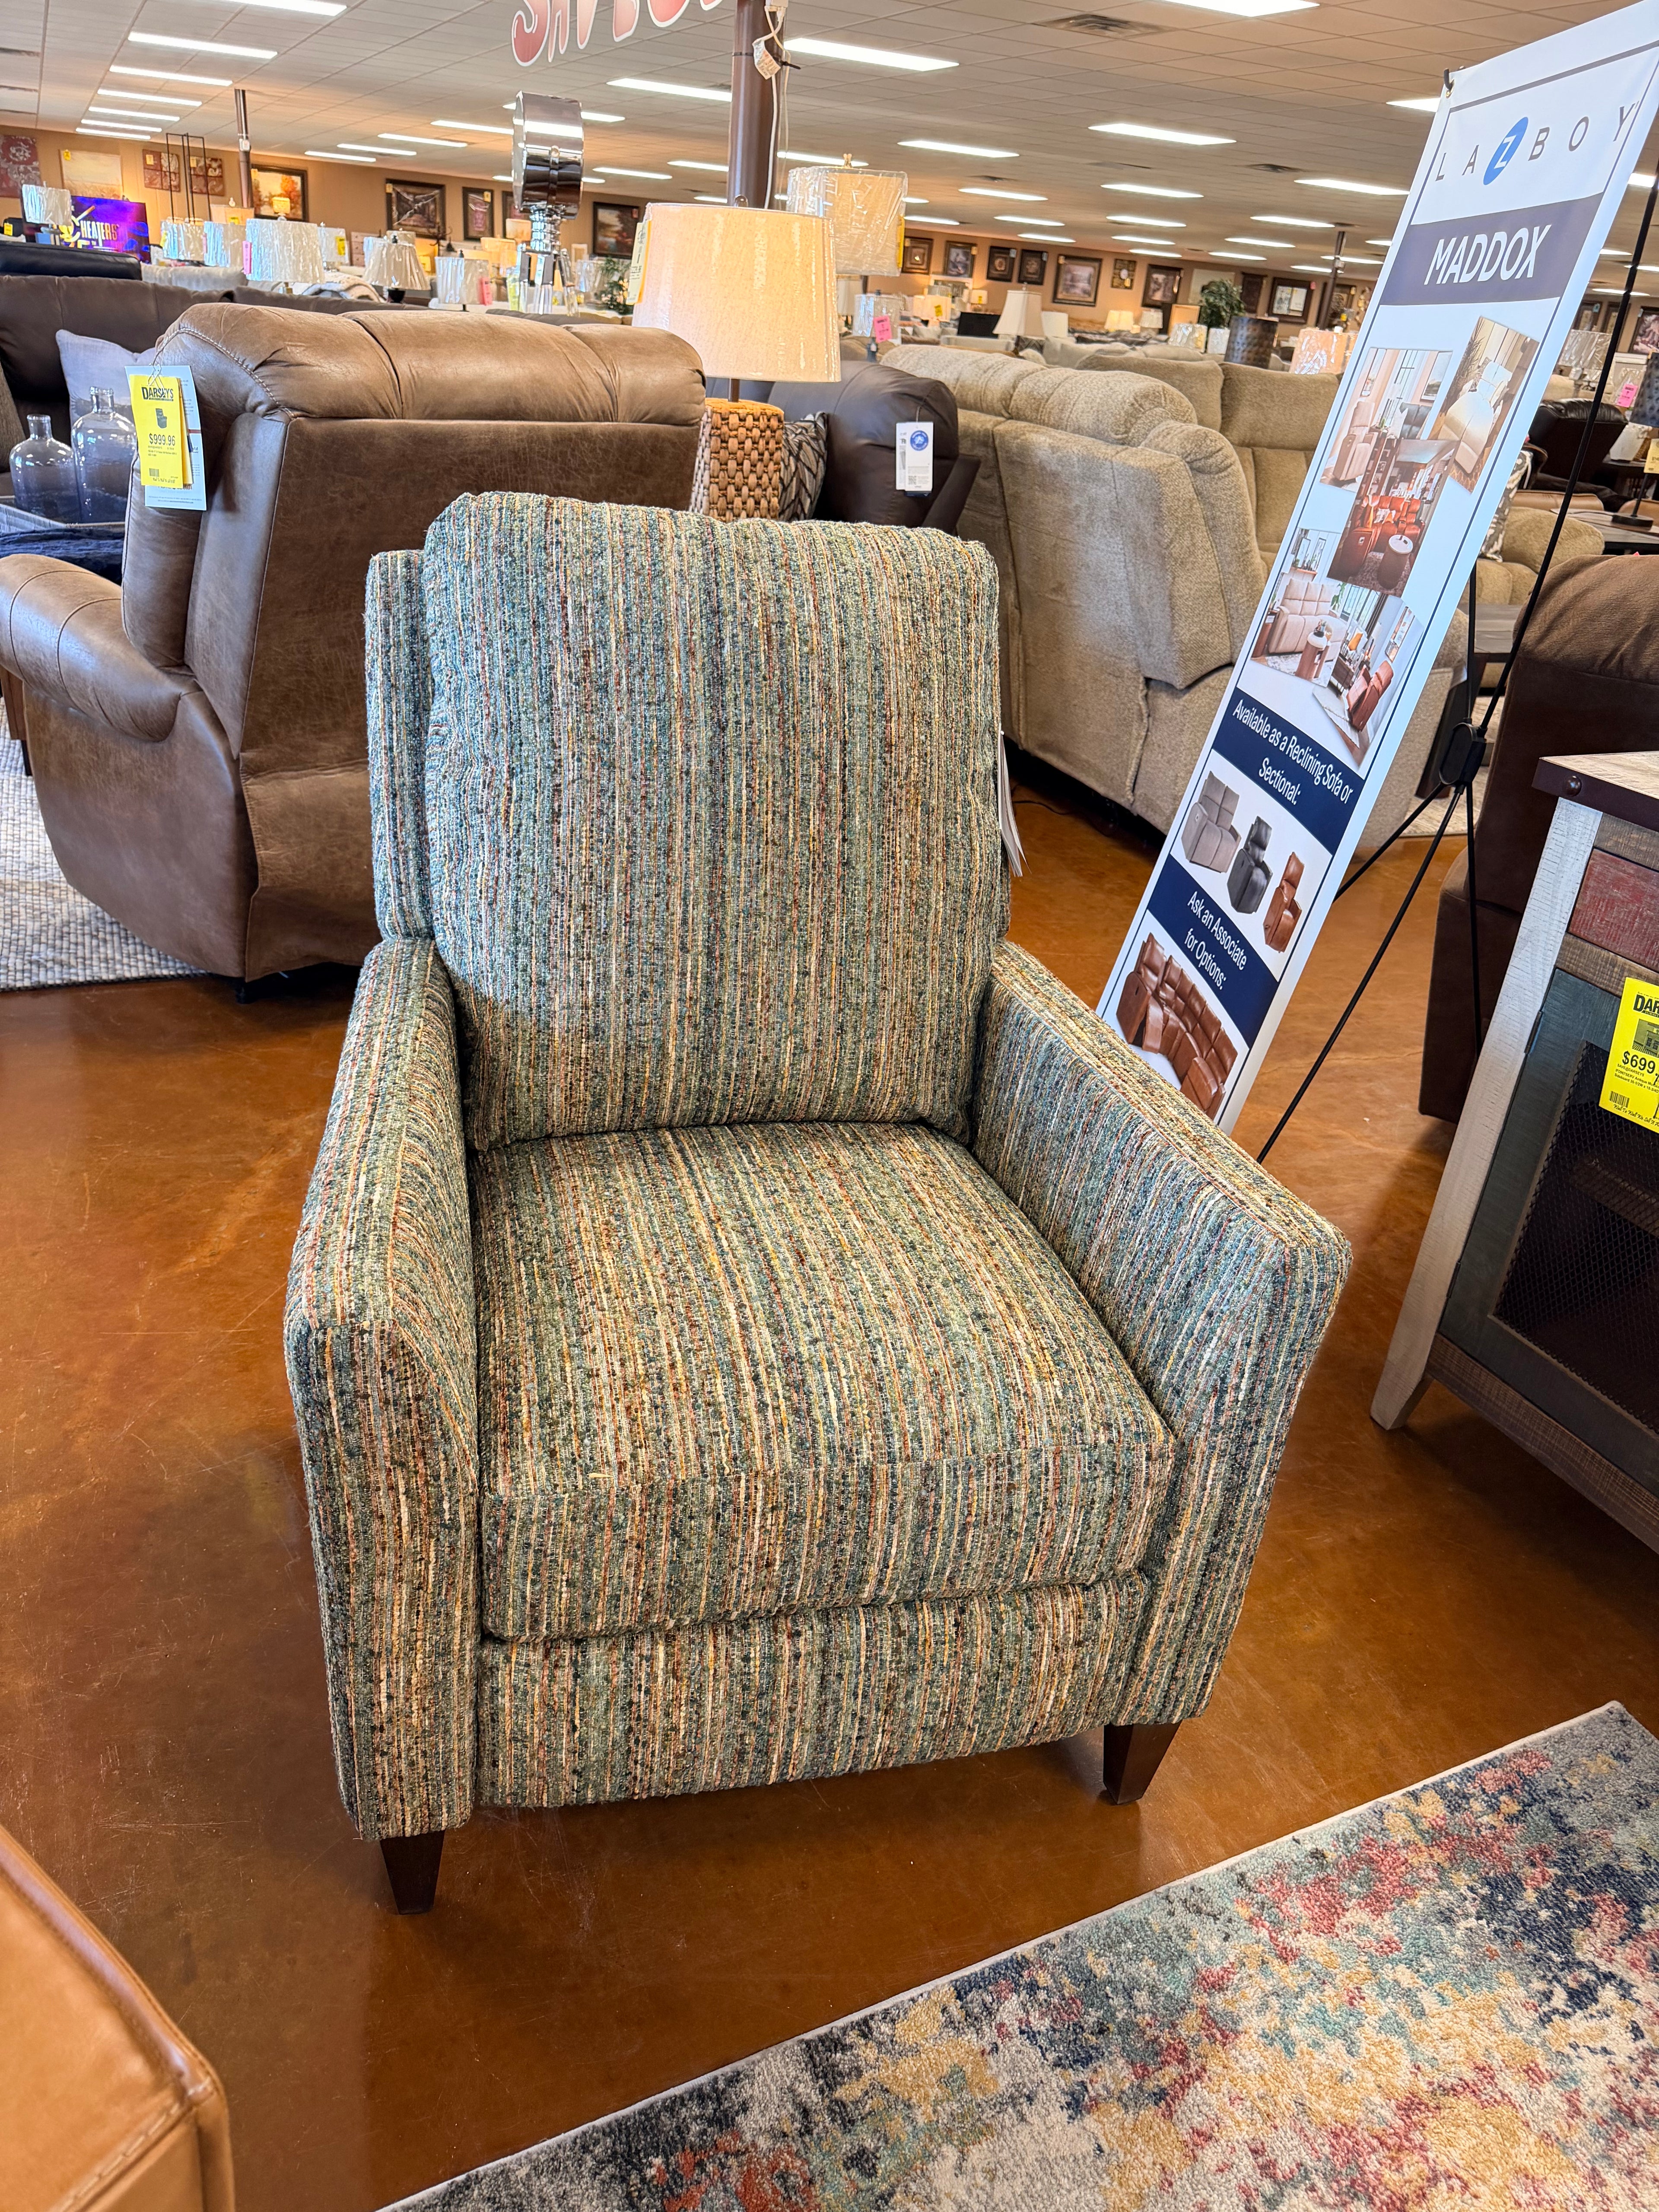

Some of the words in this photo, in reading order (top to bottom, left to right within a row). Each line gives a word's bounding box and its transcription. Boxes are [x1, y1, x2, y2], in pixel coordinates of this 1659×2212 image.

[1424, 224, 1552, 285] MADDOX
[149, 433, 175, 446] $999.96
[1233, 699, 1271, 738] Available
[1268, 728, 1281, 747] as
[1279, 736, 1288, 751] a
[1285, 736, 1326, 785] Reclining
[1322, 764, 1343, 796] Sofa
[1340, 785, 1354, 804] or
[1259, 758, 1301, 805] Sectional:
[1184, 928, 1198, 951] for
[1195, 941, 1227, 990] Options:
[1187, 891, 1205, 918] Ask
[1201, 909, 1214, 929] an
[1211, 918, 1247, 970] Associate
